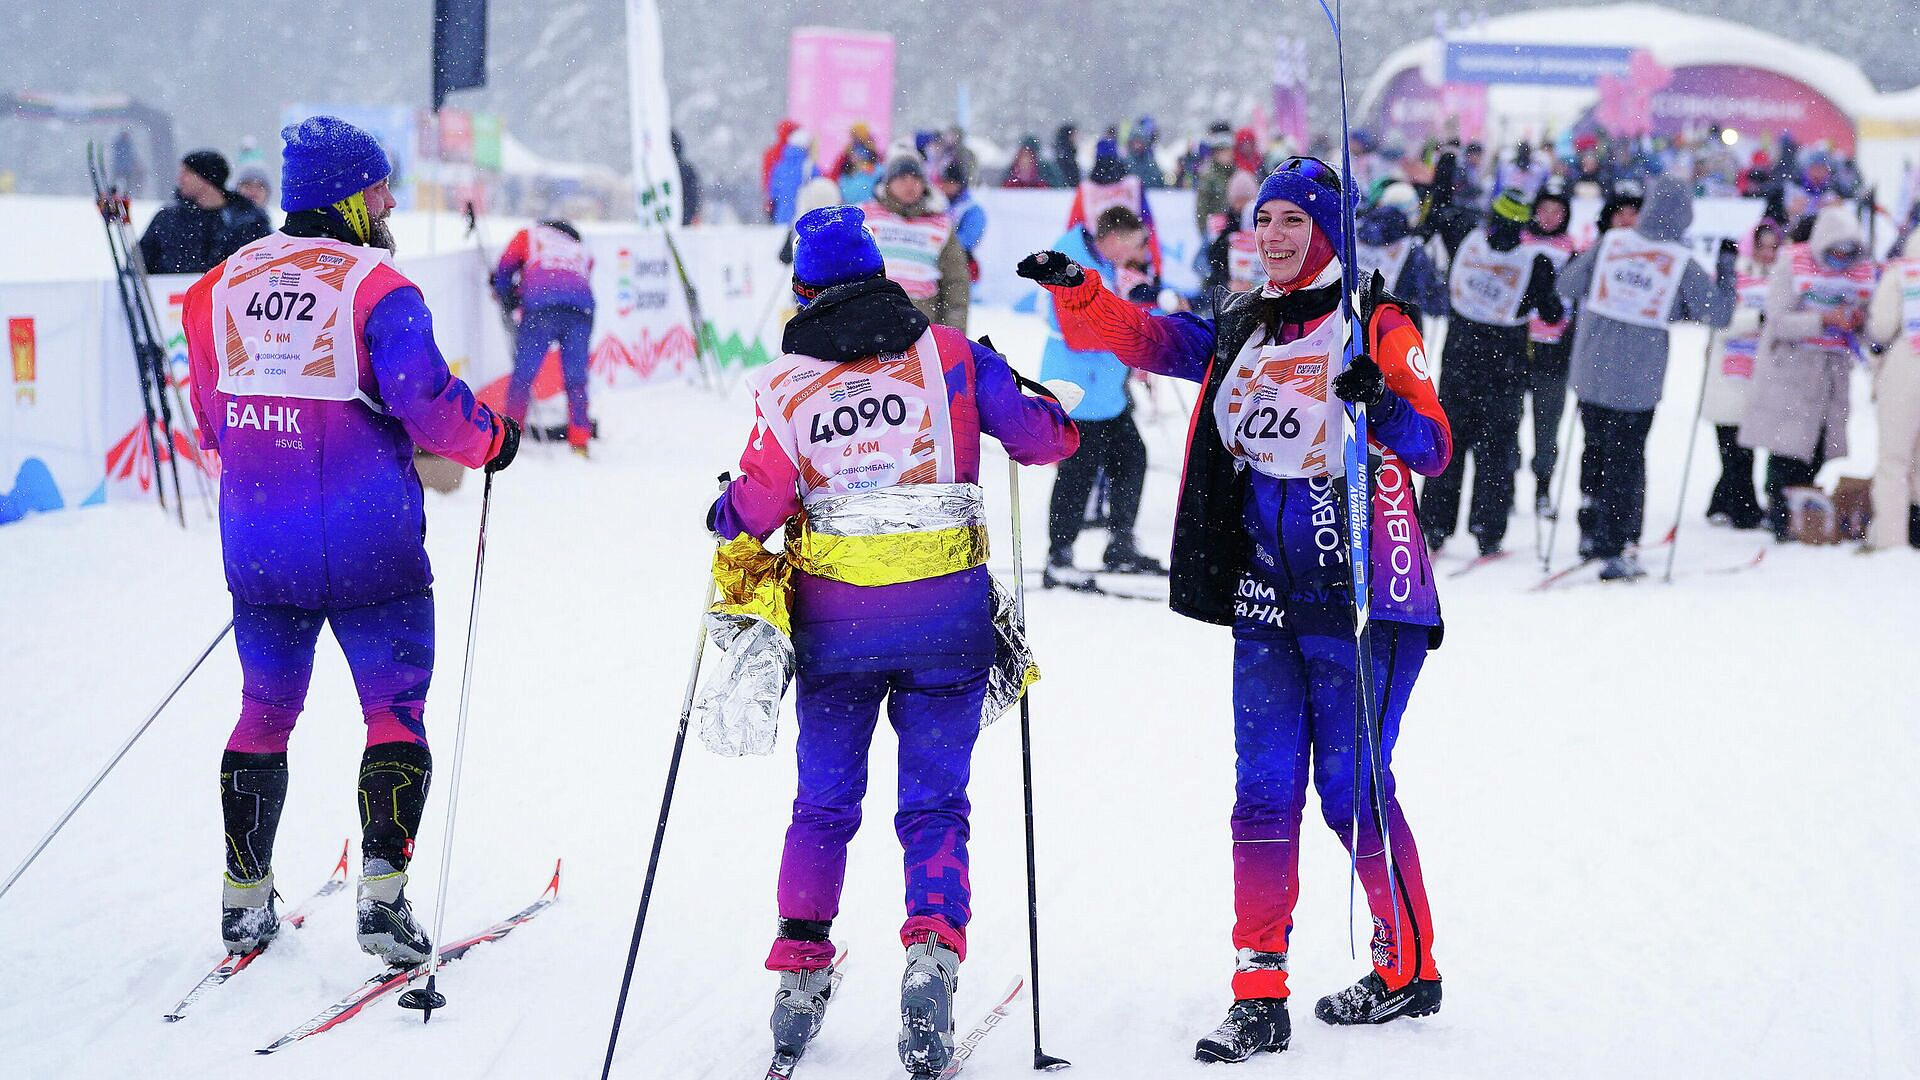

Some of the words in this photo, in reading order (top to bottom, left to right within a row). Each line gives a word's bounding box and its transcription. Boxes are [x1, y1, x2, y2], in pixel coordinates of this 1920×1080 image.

[246, 291, 317, 321] 4072
[264, 329, 271, 343] 6
[795, 382, 823, 403] 14.02.2026
[226, 401, 301, 434] БАНК
[810, 394, 906, 444] 4090
[1234, 407, 1301, 439] 026
[843, 444, 852, 457] 6
[857, 441, 880, 454] КМ
[847, 481, 878, 489] OZON
[1357, 463, 1367, 530] NORDWAY
[1350, 485, 1362, 550] NORDWAY
